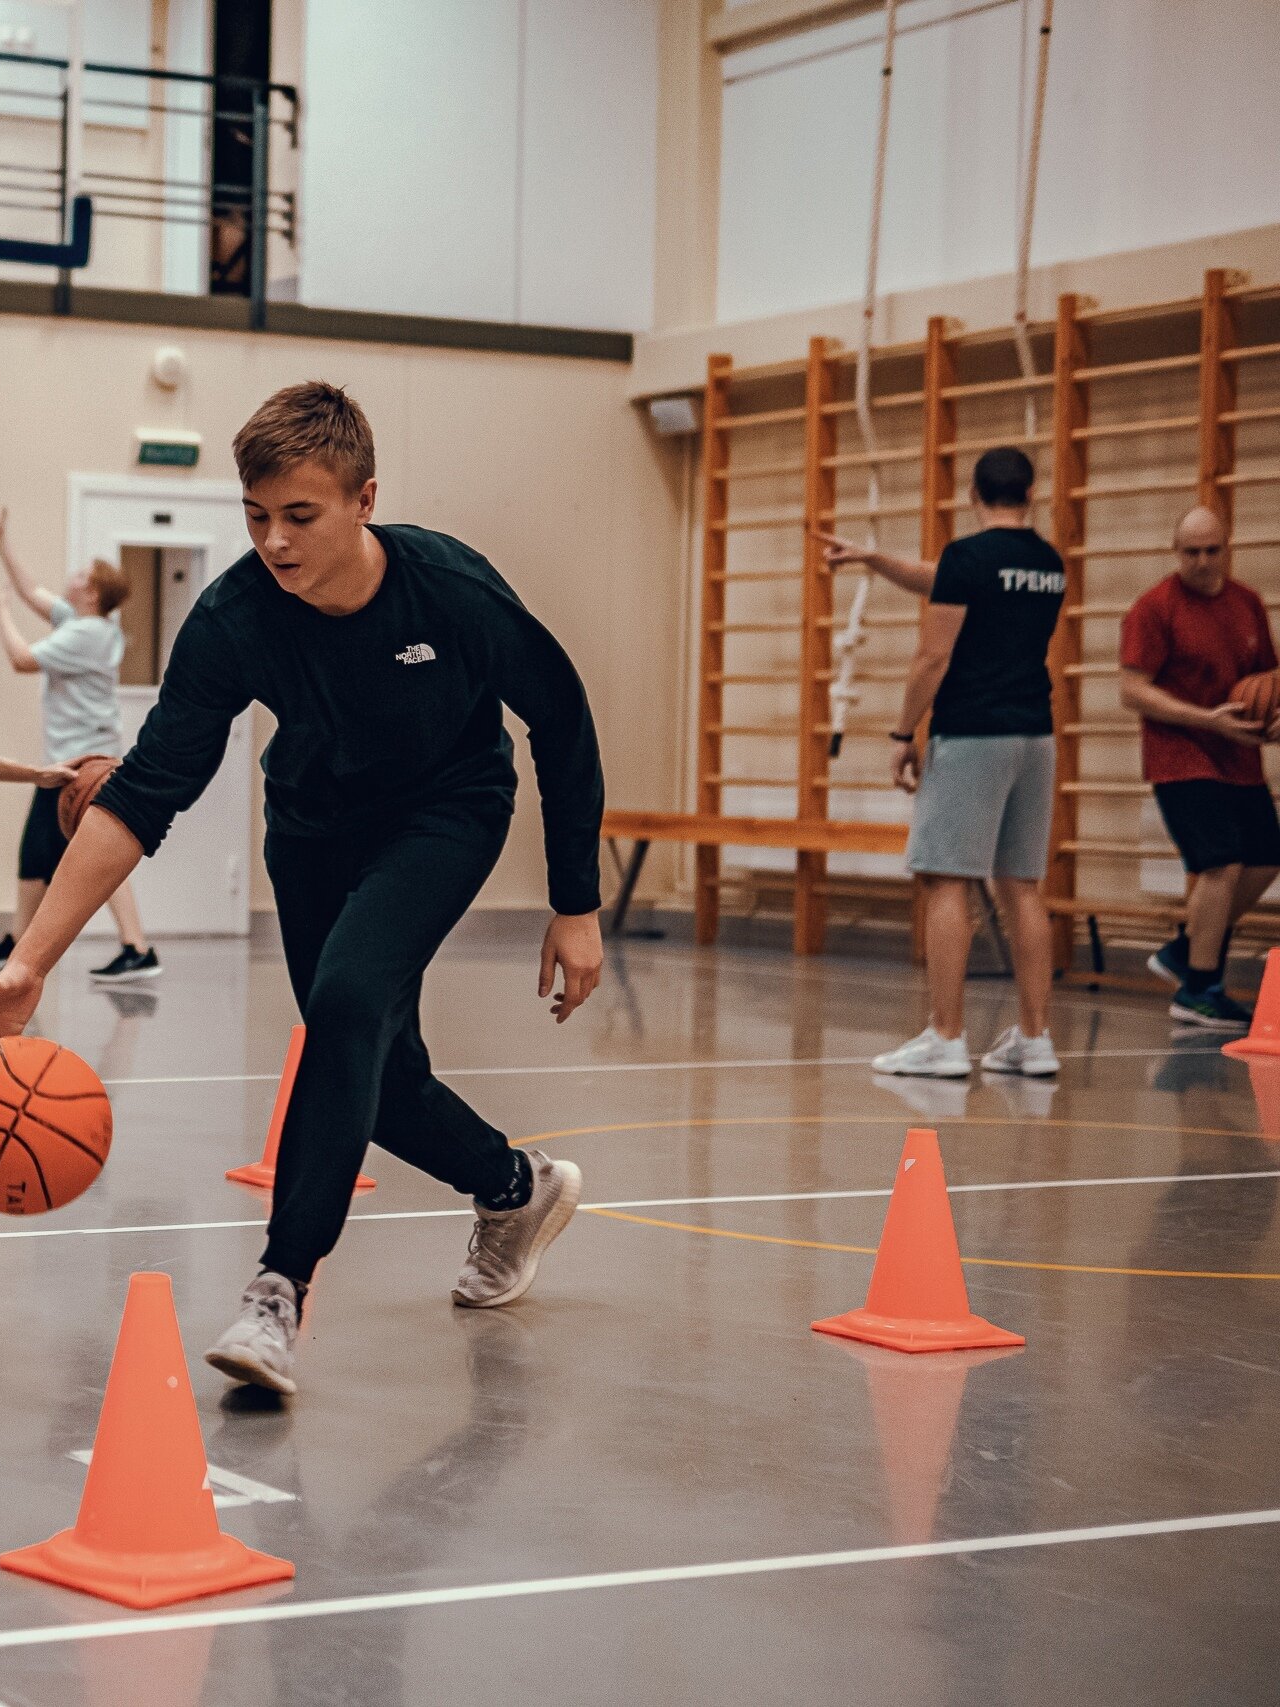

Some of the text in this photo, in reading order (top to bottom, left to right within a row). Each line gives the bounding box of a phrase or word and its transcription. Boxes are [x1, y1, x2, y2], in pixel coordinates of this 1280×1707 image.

[406, 645, 420, 653] THE
[395, 651, 421, 661] NORTH
[404, 656, 423, 665] FACE
